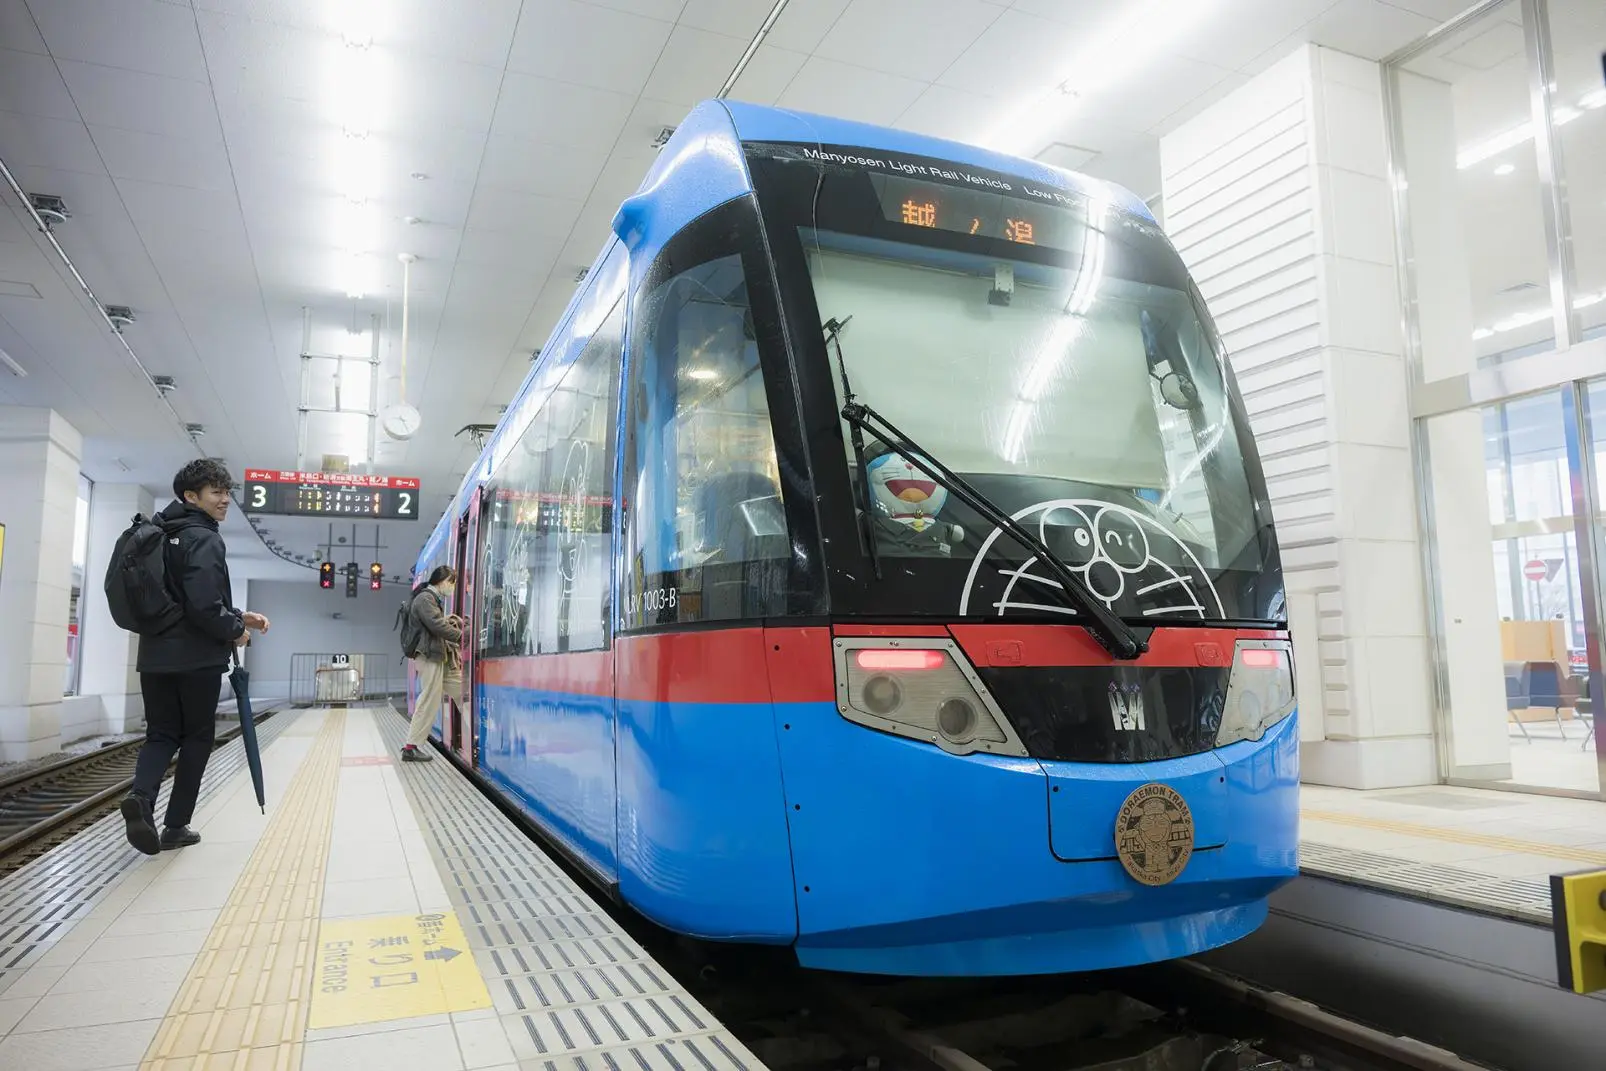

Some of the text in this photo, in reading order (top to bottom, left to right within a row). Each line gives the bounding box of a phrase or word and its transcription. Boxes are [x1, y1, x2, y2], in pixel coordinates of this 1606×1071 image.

[803, 148, 886, 168] Manyosen
[888, 160, 927, 175] Light
[929, 166, 959, 181] Rail
[960, 172, 1012, 191] Vehicle
[1023, 185, 1051, 200] Low
[250, 472, 271, 480] ホーム
[395, 479, 415, 487] ホーム
[251, 485, 267, 508] 3
[397, 492, 411, 514] 2
[643, 587, 676, 611] 1003-B
[335, 655, 347, 664] 10
[1120, 786, 1190, 824] DORAEMON TRAM
[321, 939, 354, 995] Entrance
[367, 935, 418, 989] 乗り口
